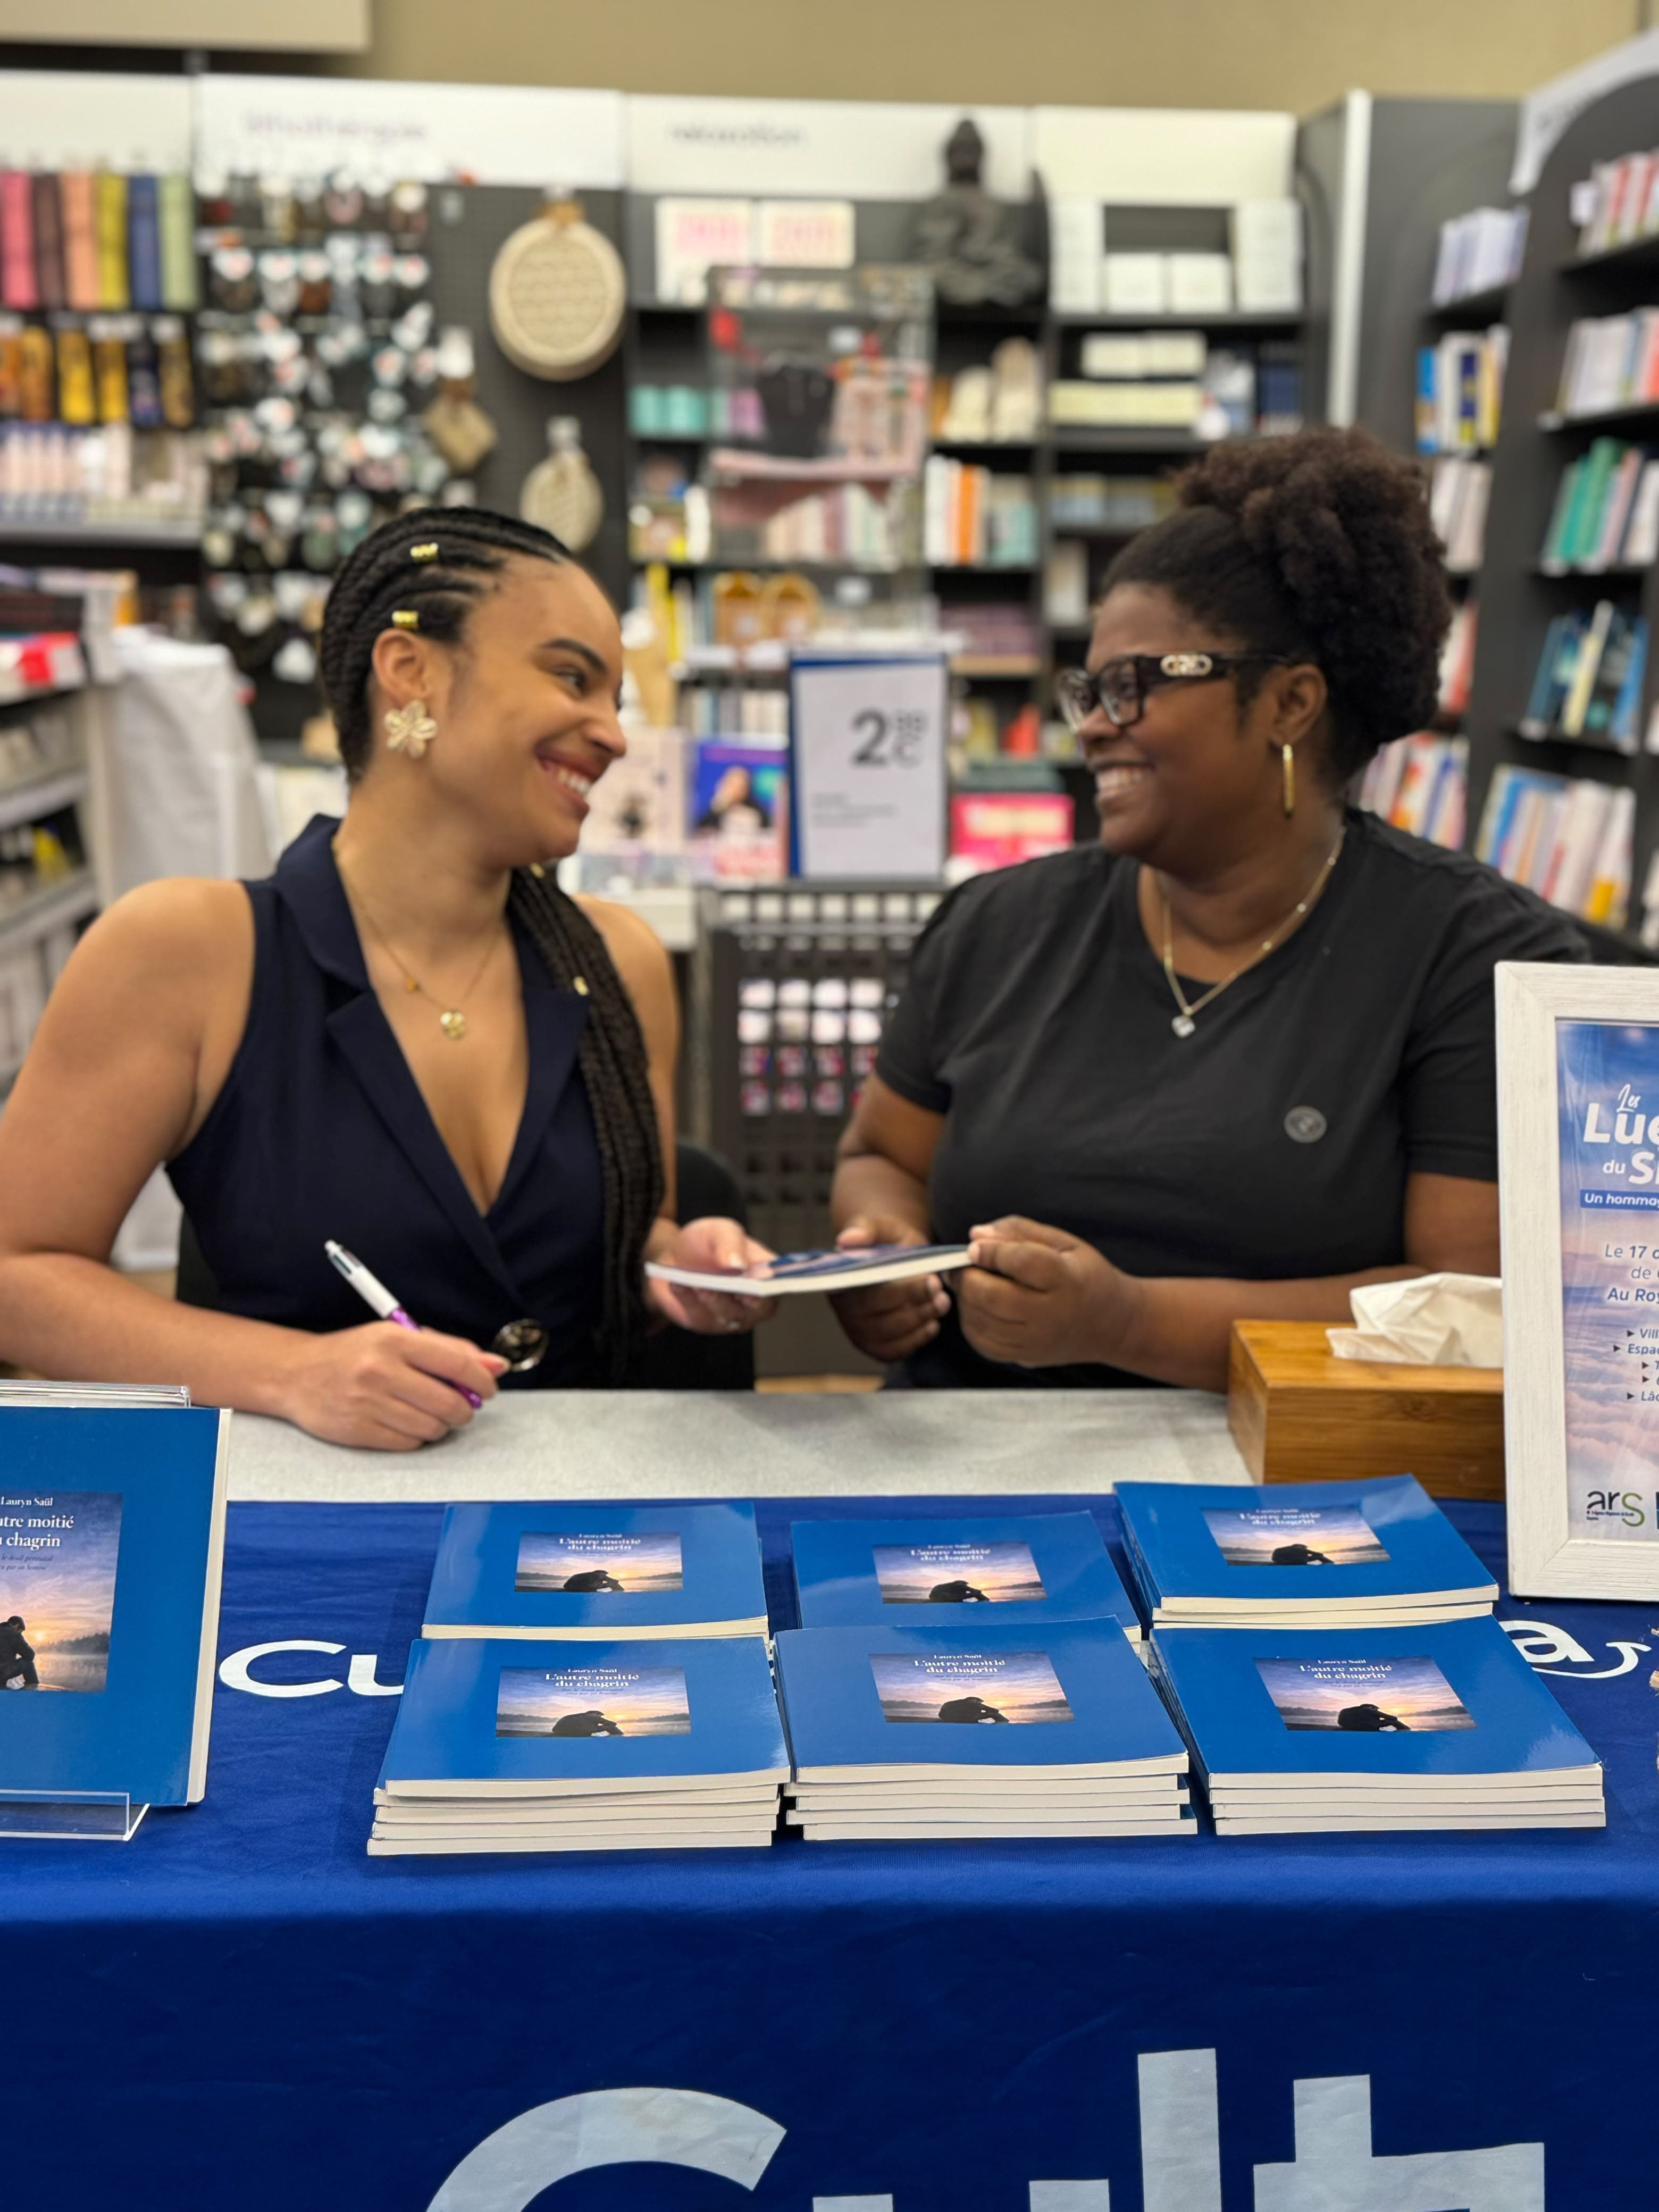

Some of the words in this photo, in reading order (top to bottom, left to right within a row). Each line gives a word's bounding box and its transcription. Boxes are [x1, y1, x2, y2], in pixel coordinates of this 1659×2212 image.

[852, 709, 887, 766] 2
[1602, 1160, 1626, 1174] du
[1585, 1193, 1602, 1204] Un
[1605, 1244, 1623, 1258] Le
[1629, 1245, 1648, 1259] 17
[1631, 1266, 1651, 1279] de
[1607, 1287, 1630, 1301] Au
[1, 1496, 32, 1508] Lauryn
[28, 1515, 74, 1528] moitié
[6, 1532, 61, 1551] chagrin
